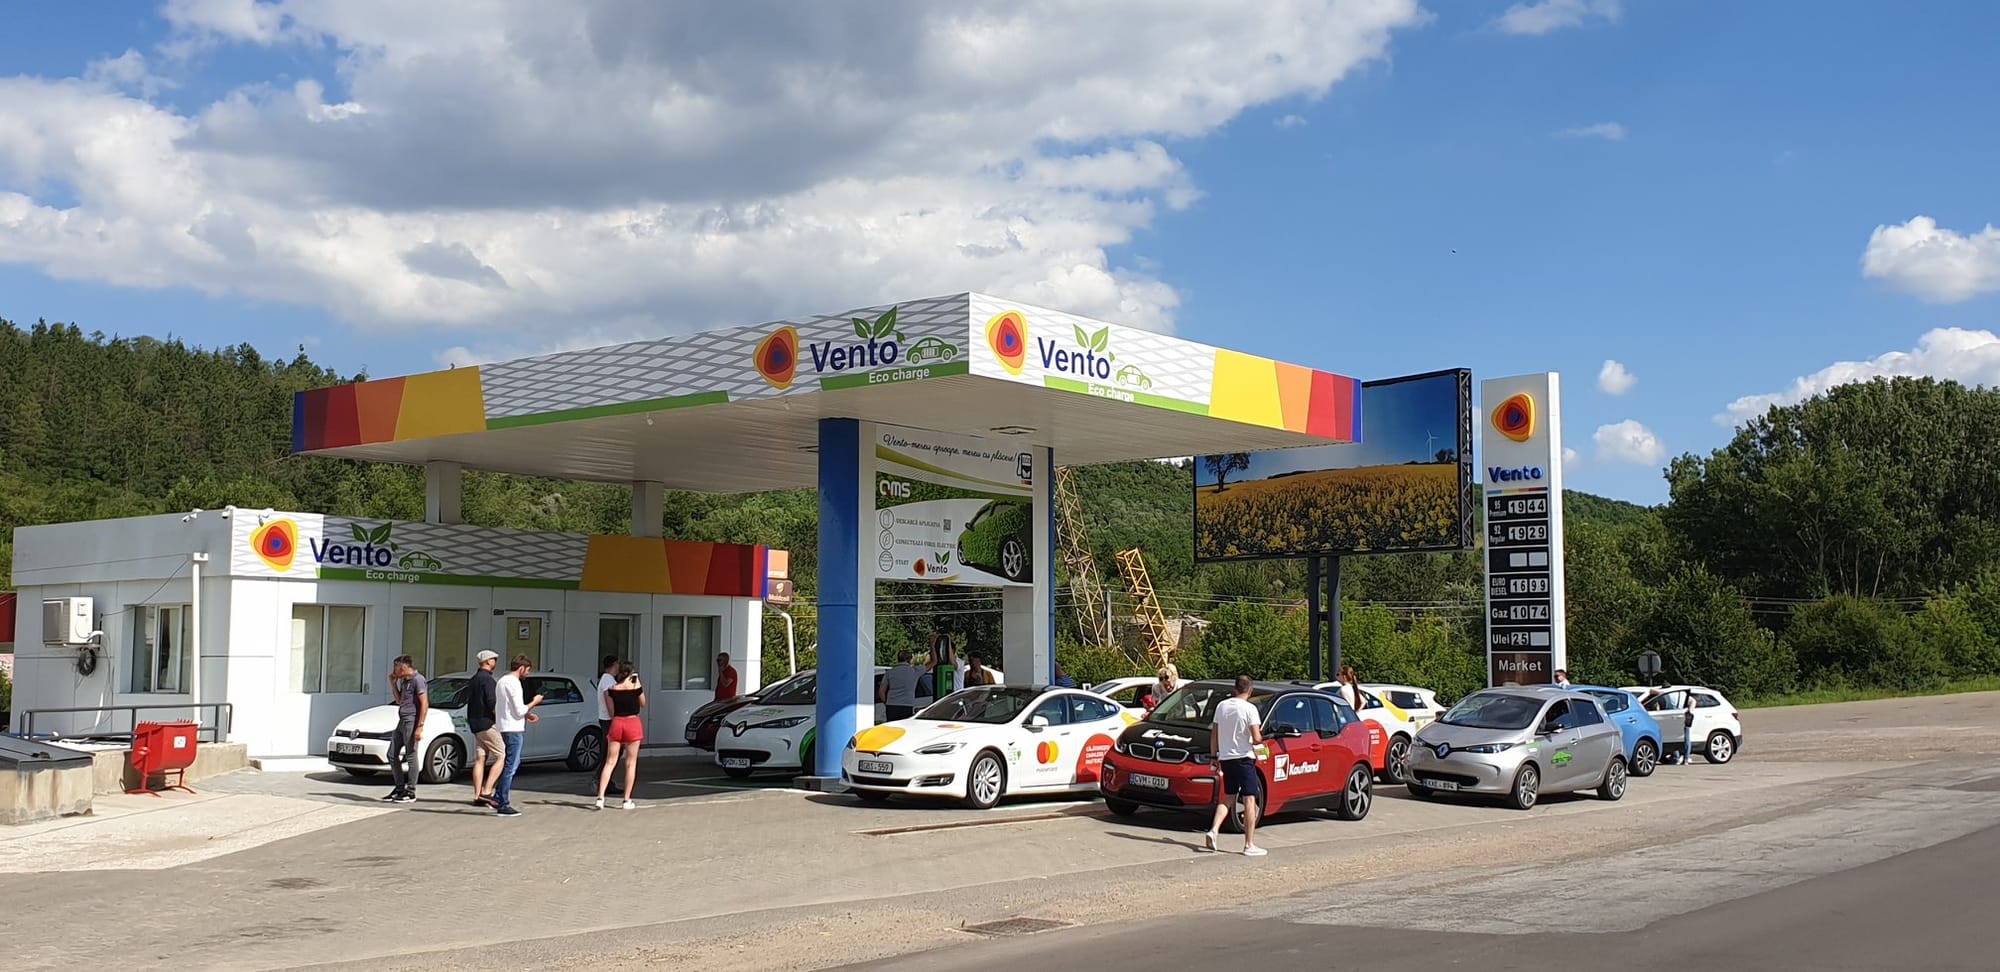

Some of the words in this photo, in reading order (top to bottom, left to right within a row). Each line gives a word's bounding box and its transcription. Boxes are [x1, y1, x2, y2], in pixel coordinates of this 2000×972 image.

[810, 337, 899, 373] Vento
[1037, 336, 1110, 380] Vento
[869, 372, 889, 384] Eco
[892, 367, 930, 382] charge
[1088, 383, 1105, 397] Eco
[1106, 387, 1135, 403] charge
[1487, 465, 1543, 484] Vento
[879, 479, 911, 498] QMS
[1493, 525, 1501, 535] 92
[309, 537, 392, 567] Vento
[926, 562, 949, 574] Vento
[366, 570, 385, 580] Eco
[387, 570, 420, 584] charge
[1491, 577, 1506, 586] EURO
[1490, 587, 1508, 596] DIESEL
[1491, 607, 1509, 619] Gaz
[1492, 633, 1510, 645] Ulei
[1512, 633, 1528, 645] 25
[1498, 659, 1542, 672] Market
[1288, 759, 1320, 776] Kaufland
